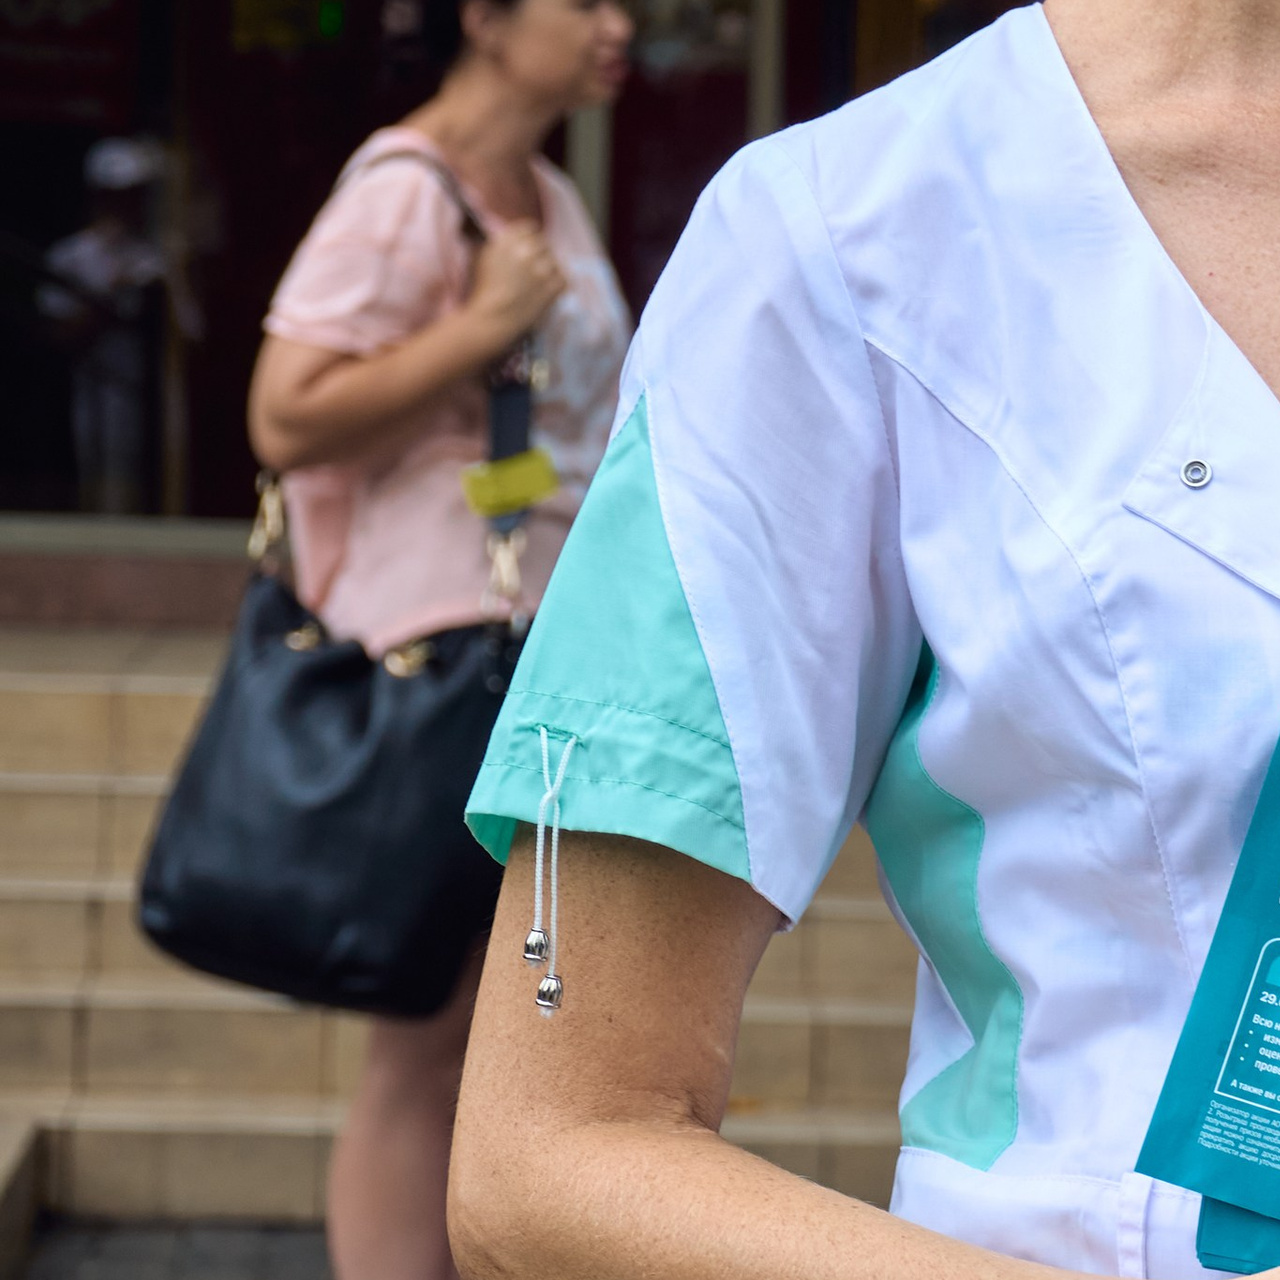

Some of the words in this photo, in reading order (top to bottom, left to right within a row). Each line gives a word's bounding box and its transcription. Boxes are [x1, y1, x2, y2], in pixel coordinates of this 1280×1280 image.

[1252, 1013, 1274, 1029] Всю
[1230, 1078, 1238, 1088] А
[1238, 1082, 1264, 1096] также
[1263, 1090, 1277, 1100] вы
